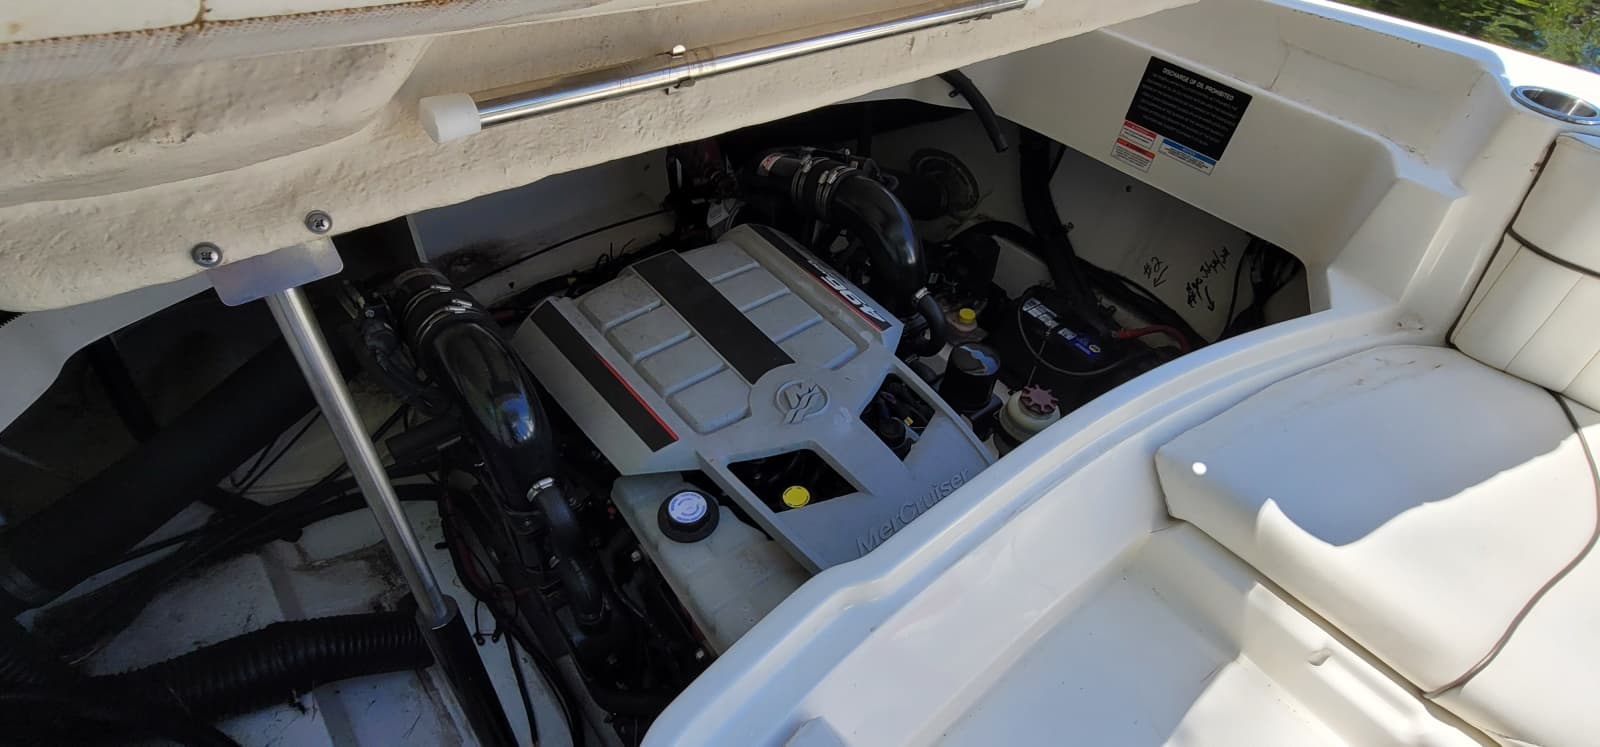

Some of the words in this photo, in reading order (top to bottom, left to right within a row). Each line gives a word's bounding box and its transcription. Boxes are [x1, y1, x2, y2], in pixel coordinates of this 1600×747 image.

[1162, 67, 1190, 85] DISCHARGE
[1196, 81, 1205, 90] OIL
[1204, 84, 1235, 101] PROHIBITED
[820, 273, 886, 322] 496
[855, 468, 969, 559] MerCruiser
